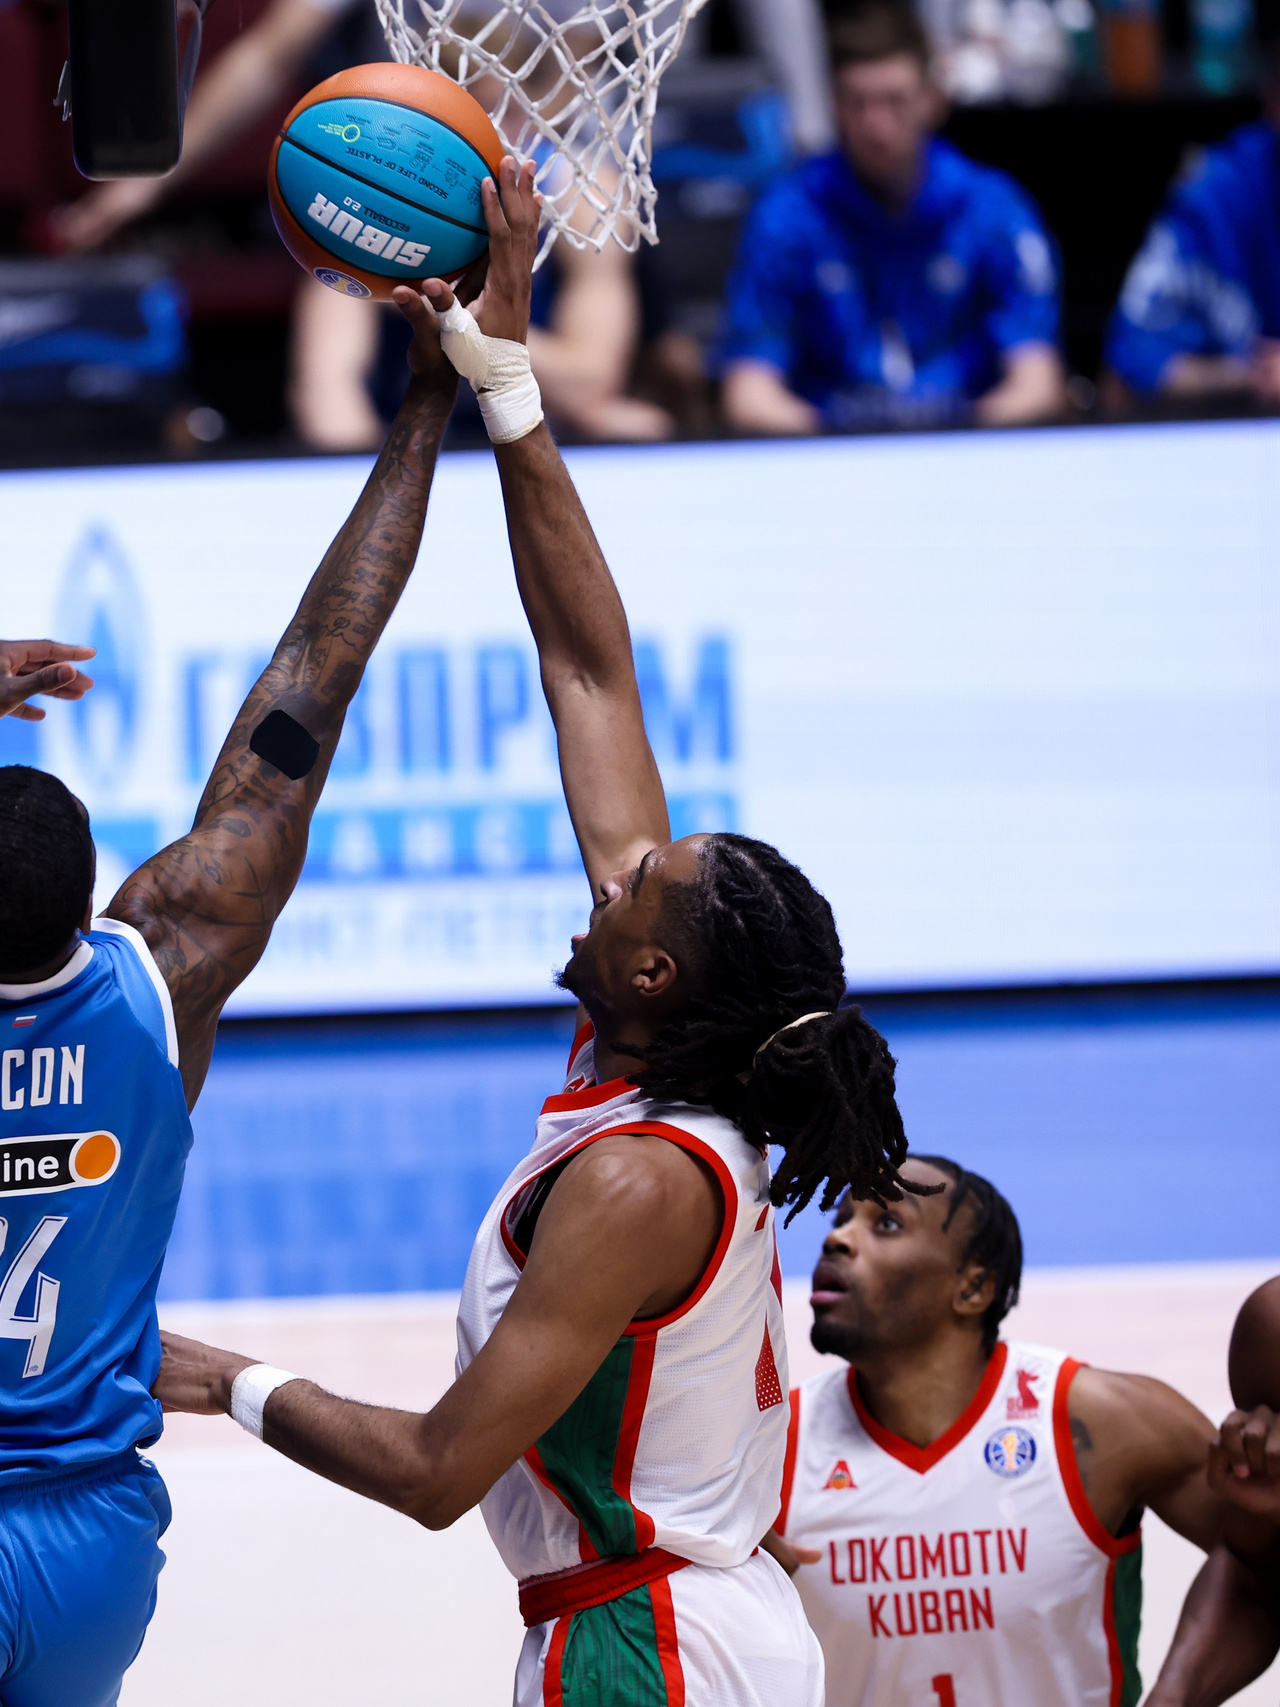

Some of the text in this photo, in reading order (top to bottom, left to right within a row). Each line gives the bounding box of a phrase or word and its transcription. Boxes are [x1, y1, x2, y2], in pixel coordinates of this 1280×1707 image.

[345, 146, 383, 165] PLASTIC
[383, 161, 397, 171] OF
[396, 167, 418, 181] LIFE
[418, 176, 449, 199] SECOND
[343, 196, 362, 212] 2.0
[307, 192, 432, 267] SIBUR
[828, 1527, 1028, 1586] LOKOMOTIV
[867, 1587, 995, 1638] KUBAN
